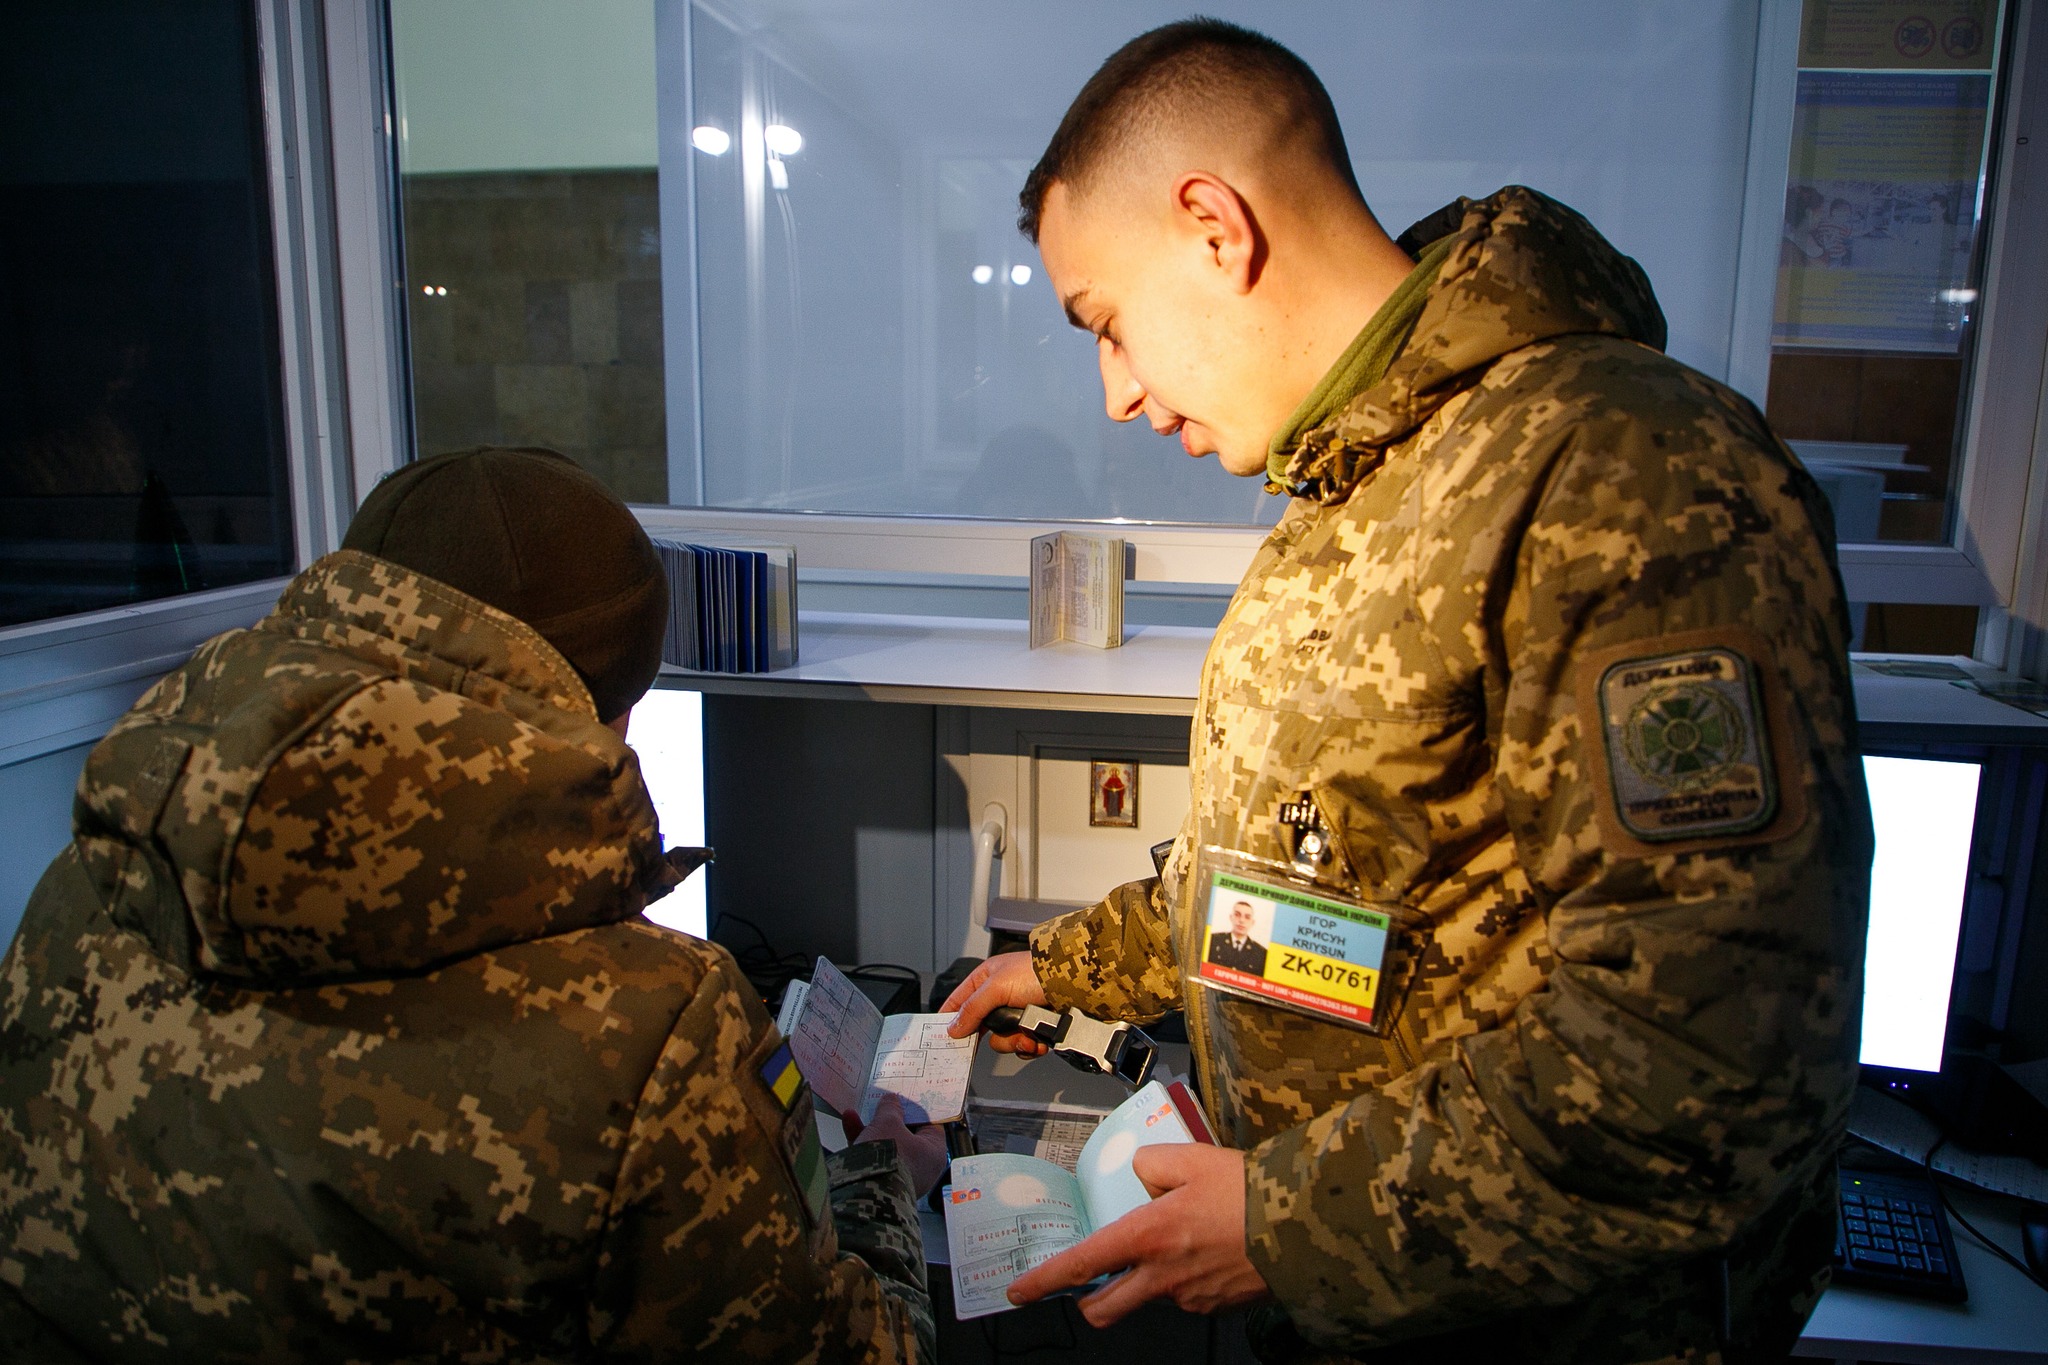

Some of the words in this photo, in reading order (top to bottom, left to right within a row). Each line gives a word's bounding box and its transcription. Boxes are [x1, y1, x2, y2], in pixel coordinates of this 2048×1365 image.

[1309, 915, 1337, 929] ІГОР
[1297, 925, 1346, 946] КРИСУН
[1292, 937, 1346, 959] KRIYSUN
[1281, 952, 1372, 993] ZK-0761
